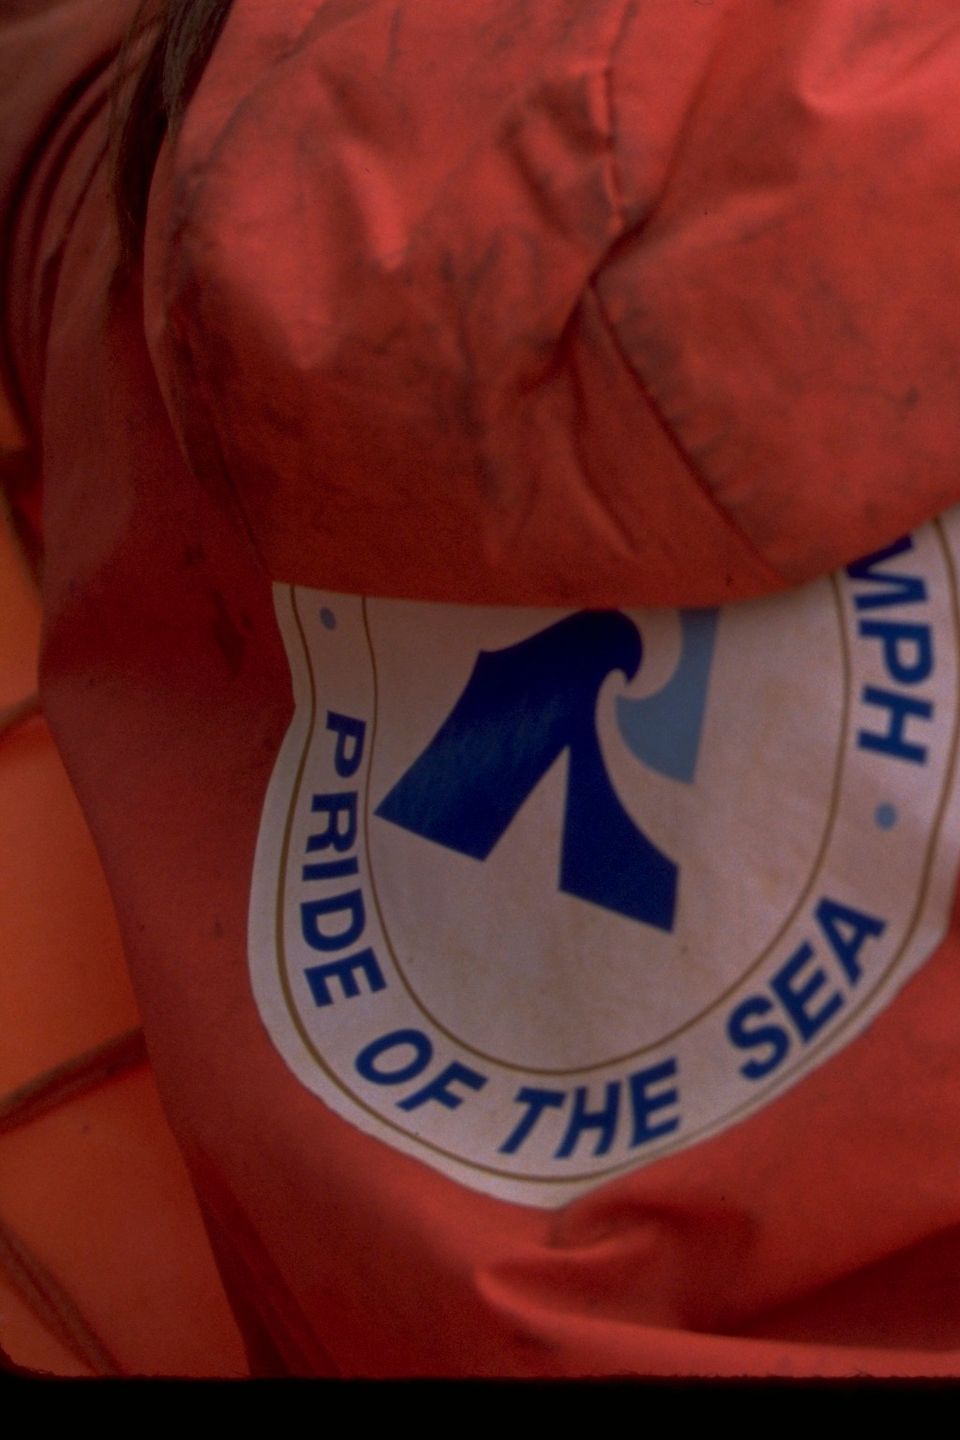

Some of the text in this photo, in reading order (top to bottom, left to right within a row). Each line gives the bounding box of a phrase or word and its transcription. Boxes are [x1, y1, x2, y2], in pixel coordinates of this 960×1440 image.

[301, 711, 886, 1159] PRIDE OF THE SEA
